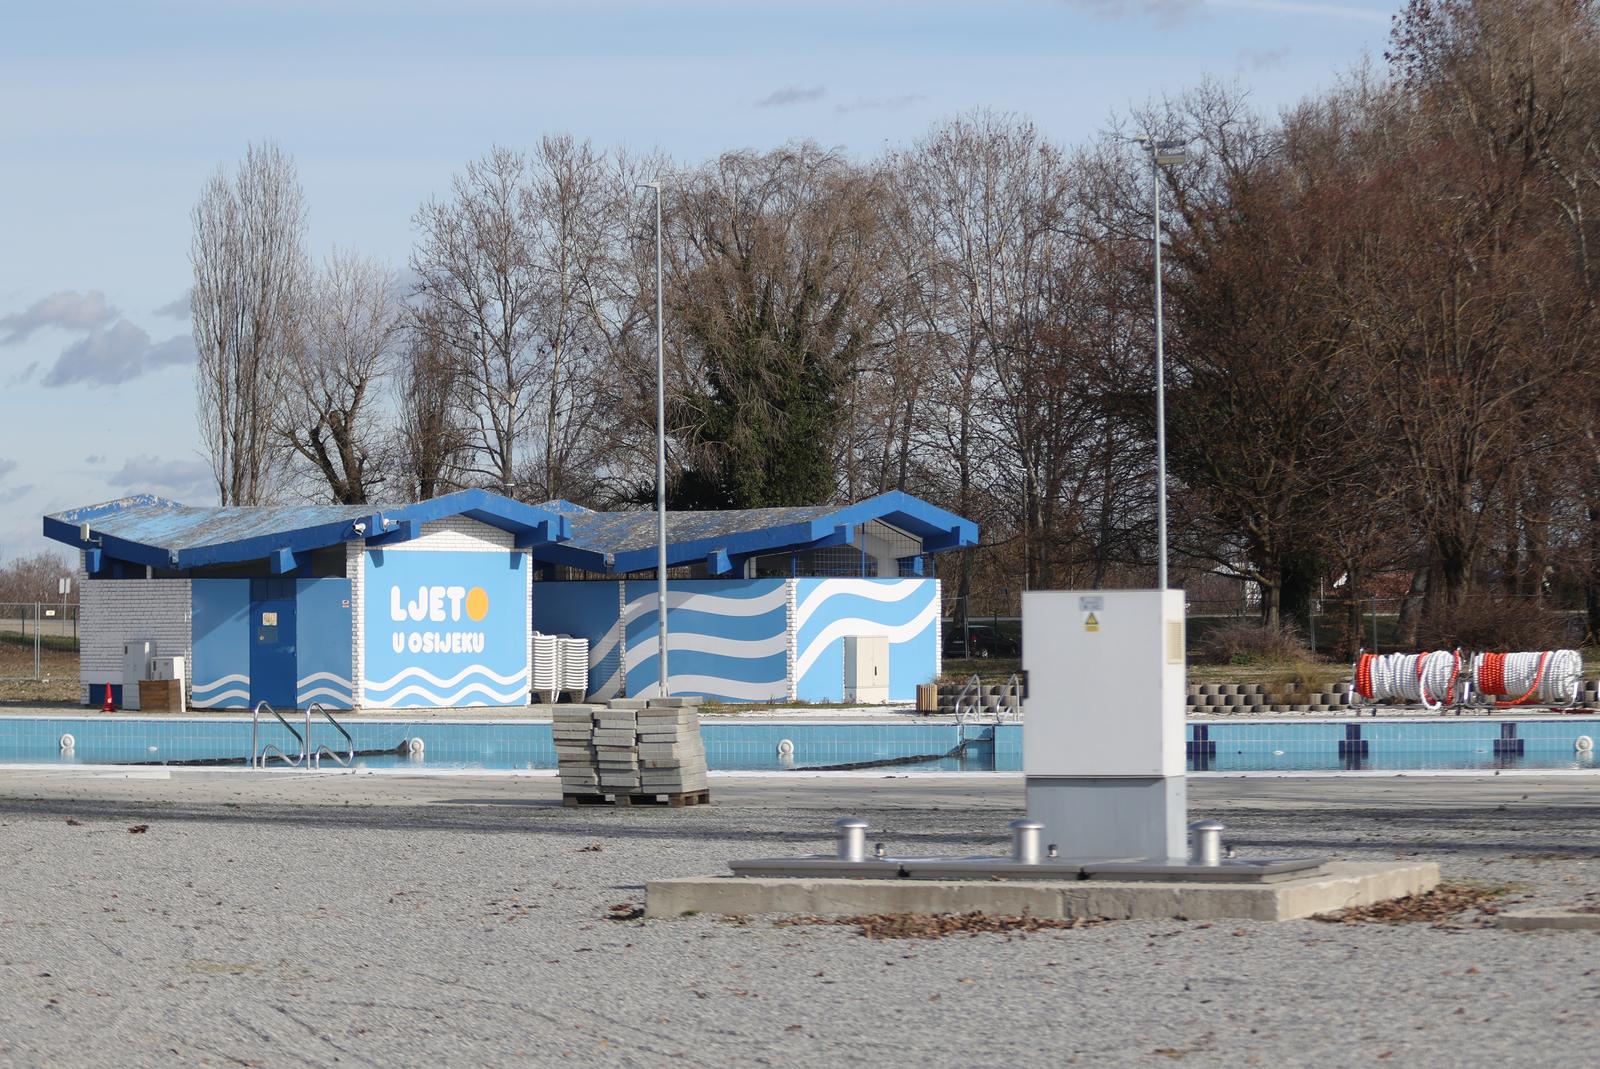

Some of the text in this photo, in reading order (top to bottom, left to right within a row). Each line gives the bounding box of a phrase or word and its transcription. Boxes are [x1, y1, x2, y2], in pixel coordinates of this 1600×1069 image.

[391, 585, 488, 622] LJETO
[392, 632, 485, 653] U OSIJEKU
